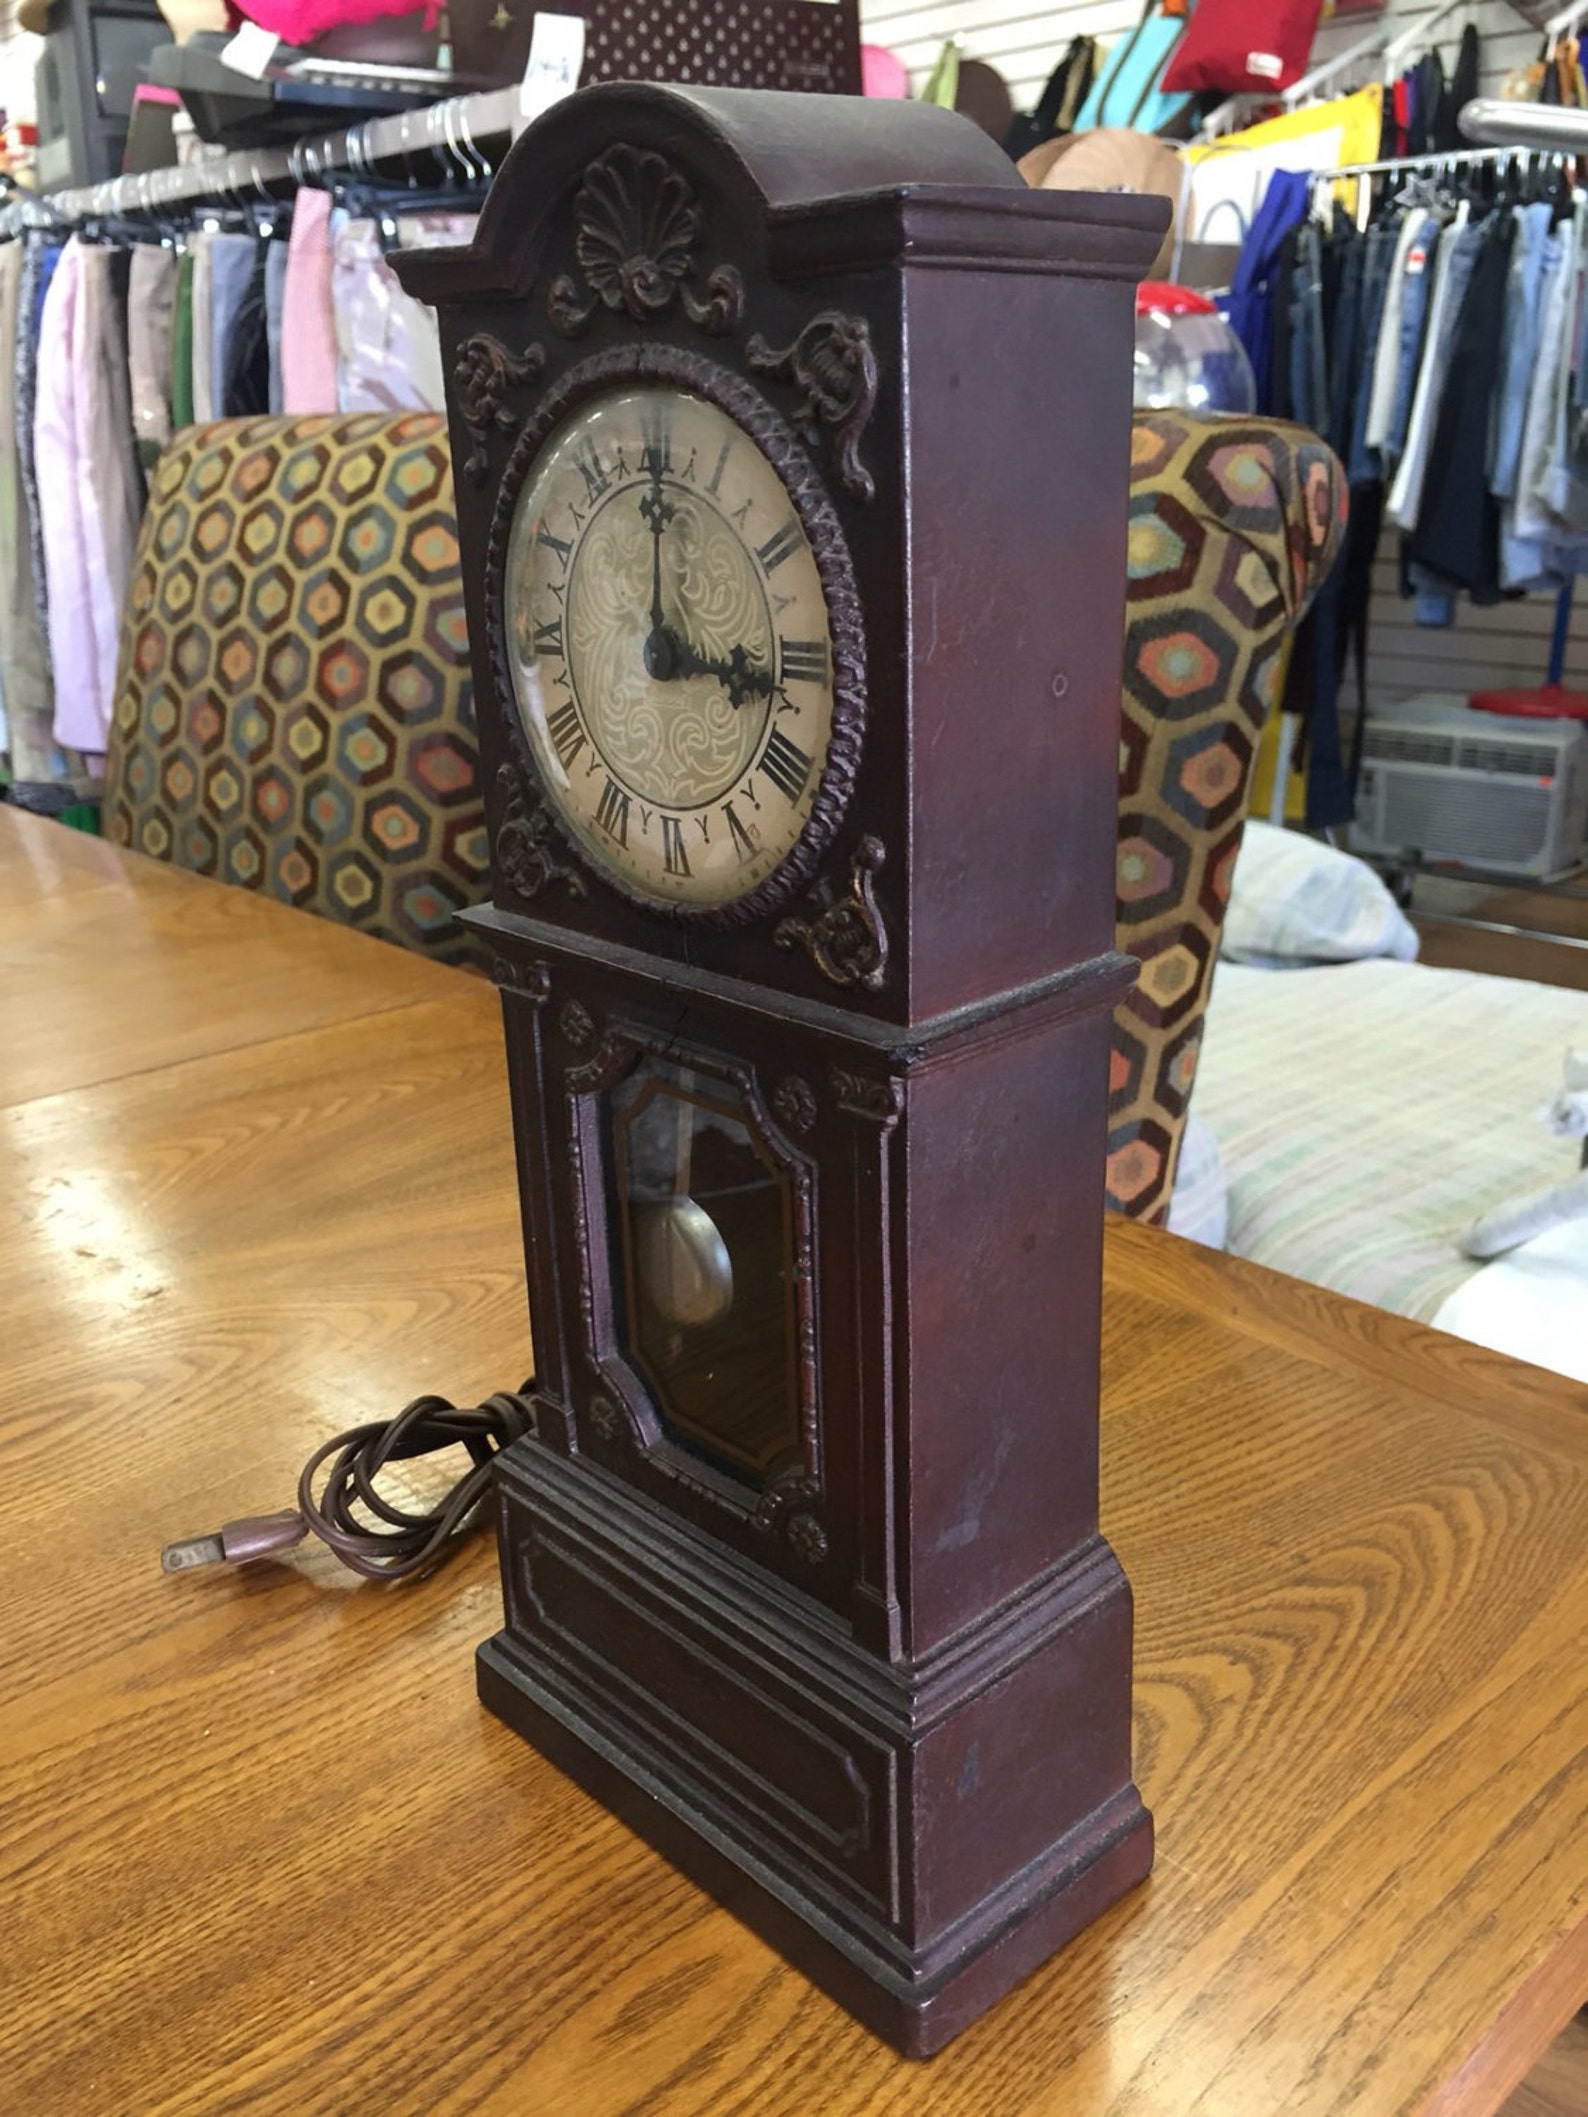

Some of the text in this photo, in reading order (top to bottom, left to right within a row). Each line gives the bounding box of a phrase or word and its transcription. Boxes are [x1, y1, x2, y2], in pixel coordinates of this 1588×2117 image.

[536, 517, 575, 575] X
[753, 512, 806, 581] II
[532, 613, 566, 662] IX
[779, 634, 829, 692] III
[545, 695, 589, 772] VIII
[755, 720, 816, 810] IIII
[591, 774, 633, 852] VII
[659, 814, 695, 878] VI
[721, 799, 765, 868] V
